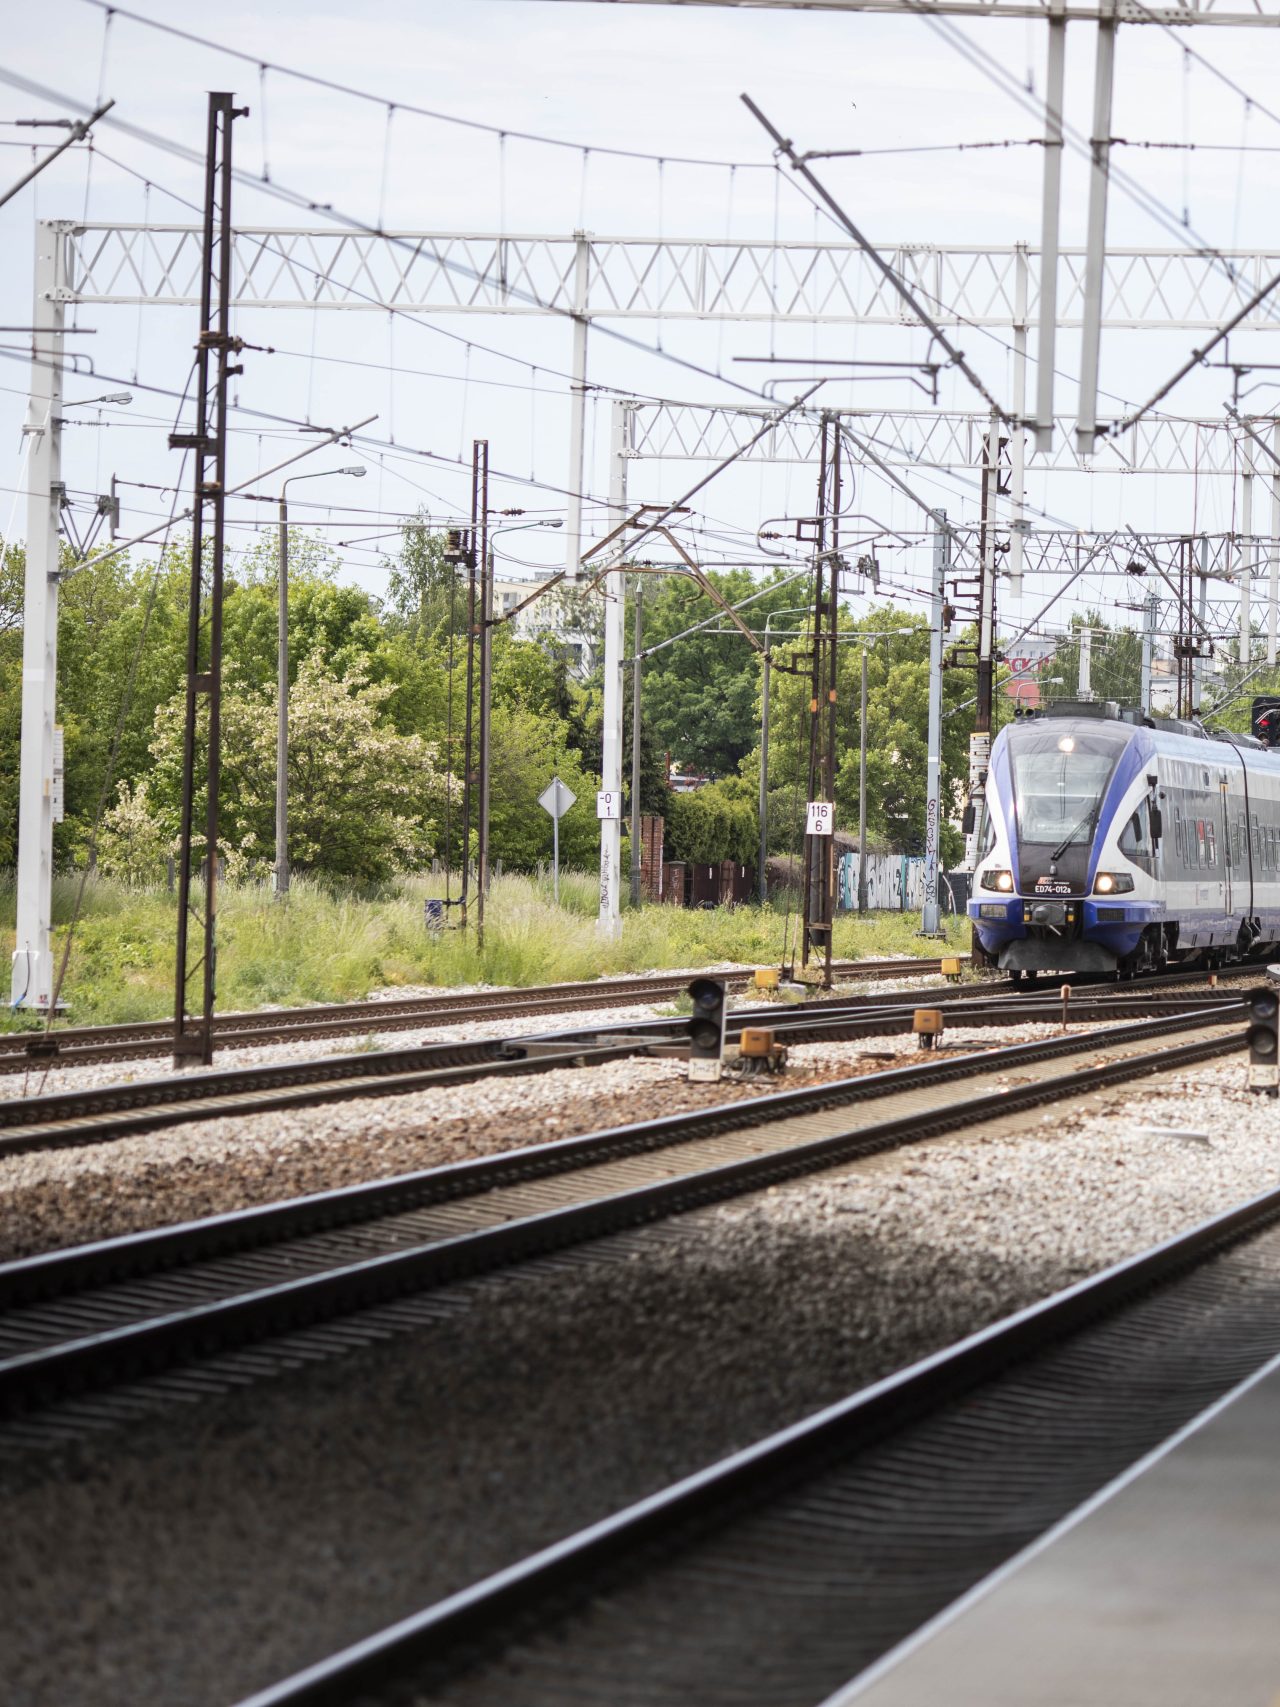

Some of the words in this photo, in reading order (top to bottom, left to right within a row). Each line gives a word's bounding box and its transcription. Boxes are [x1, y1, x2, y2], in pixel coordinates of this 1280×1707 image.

[812, 805, 828, 818] 116
[815, 820, 823, 832] 6
[1034, 885, 1072, 894] ED74-012a
